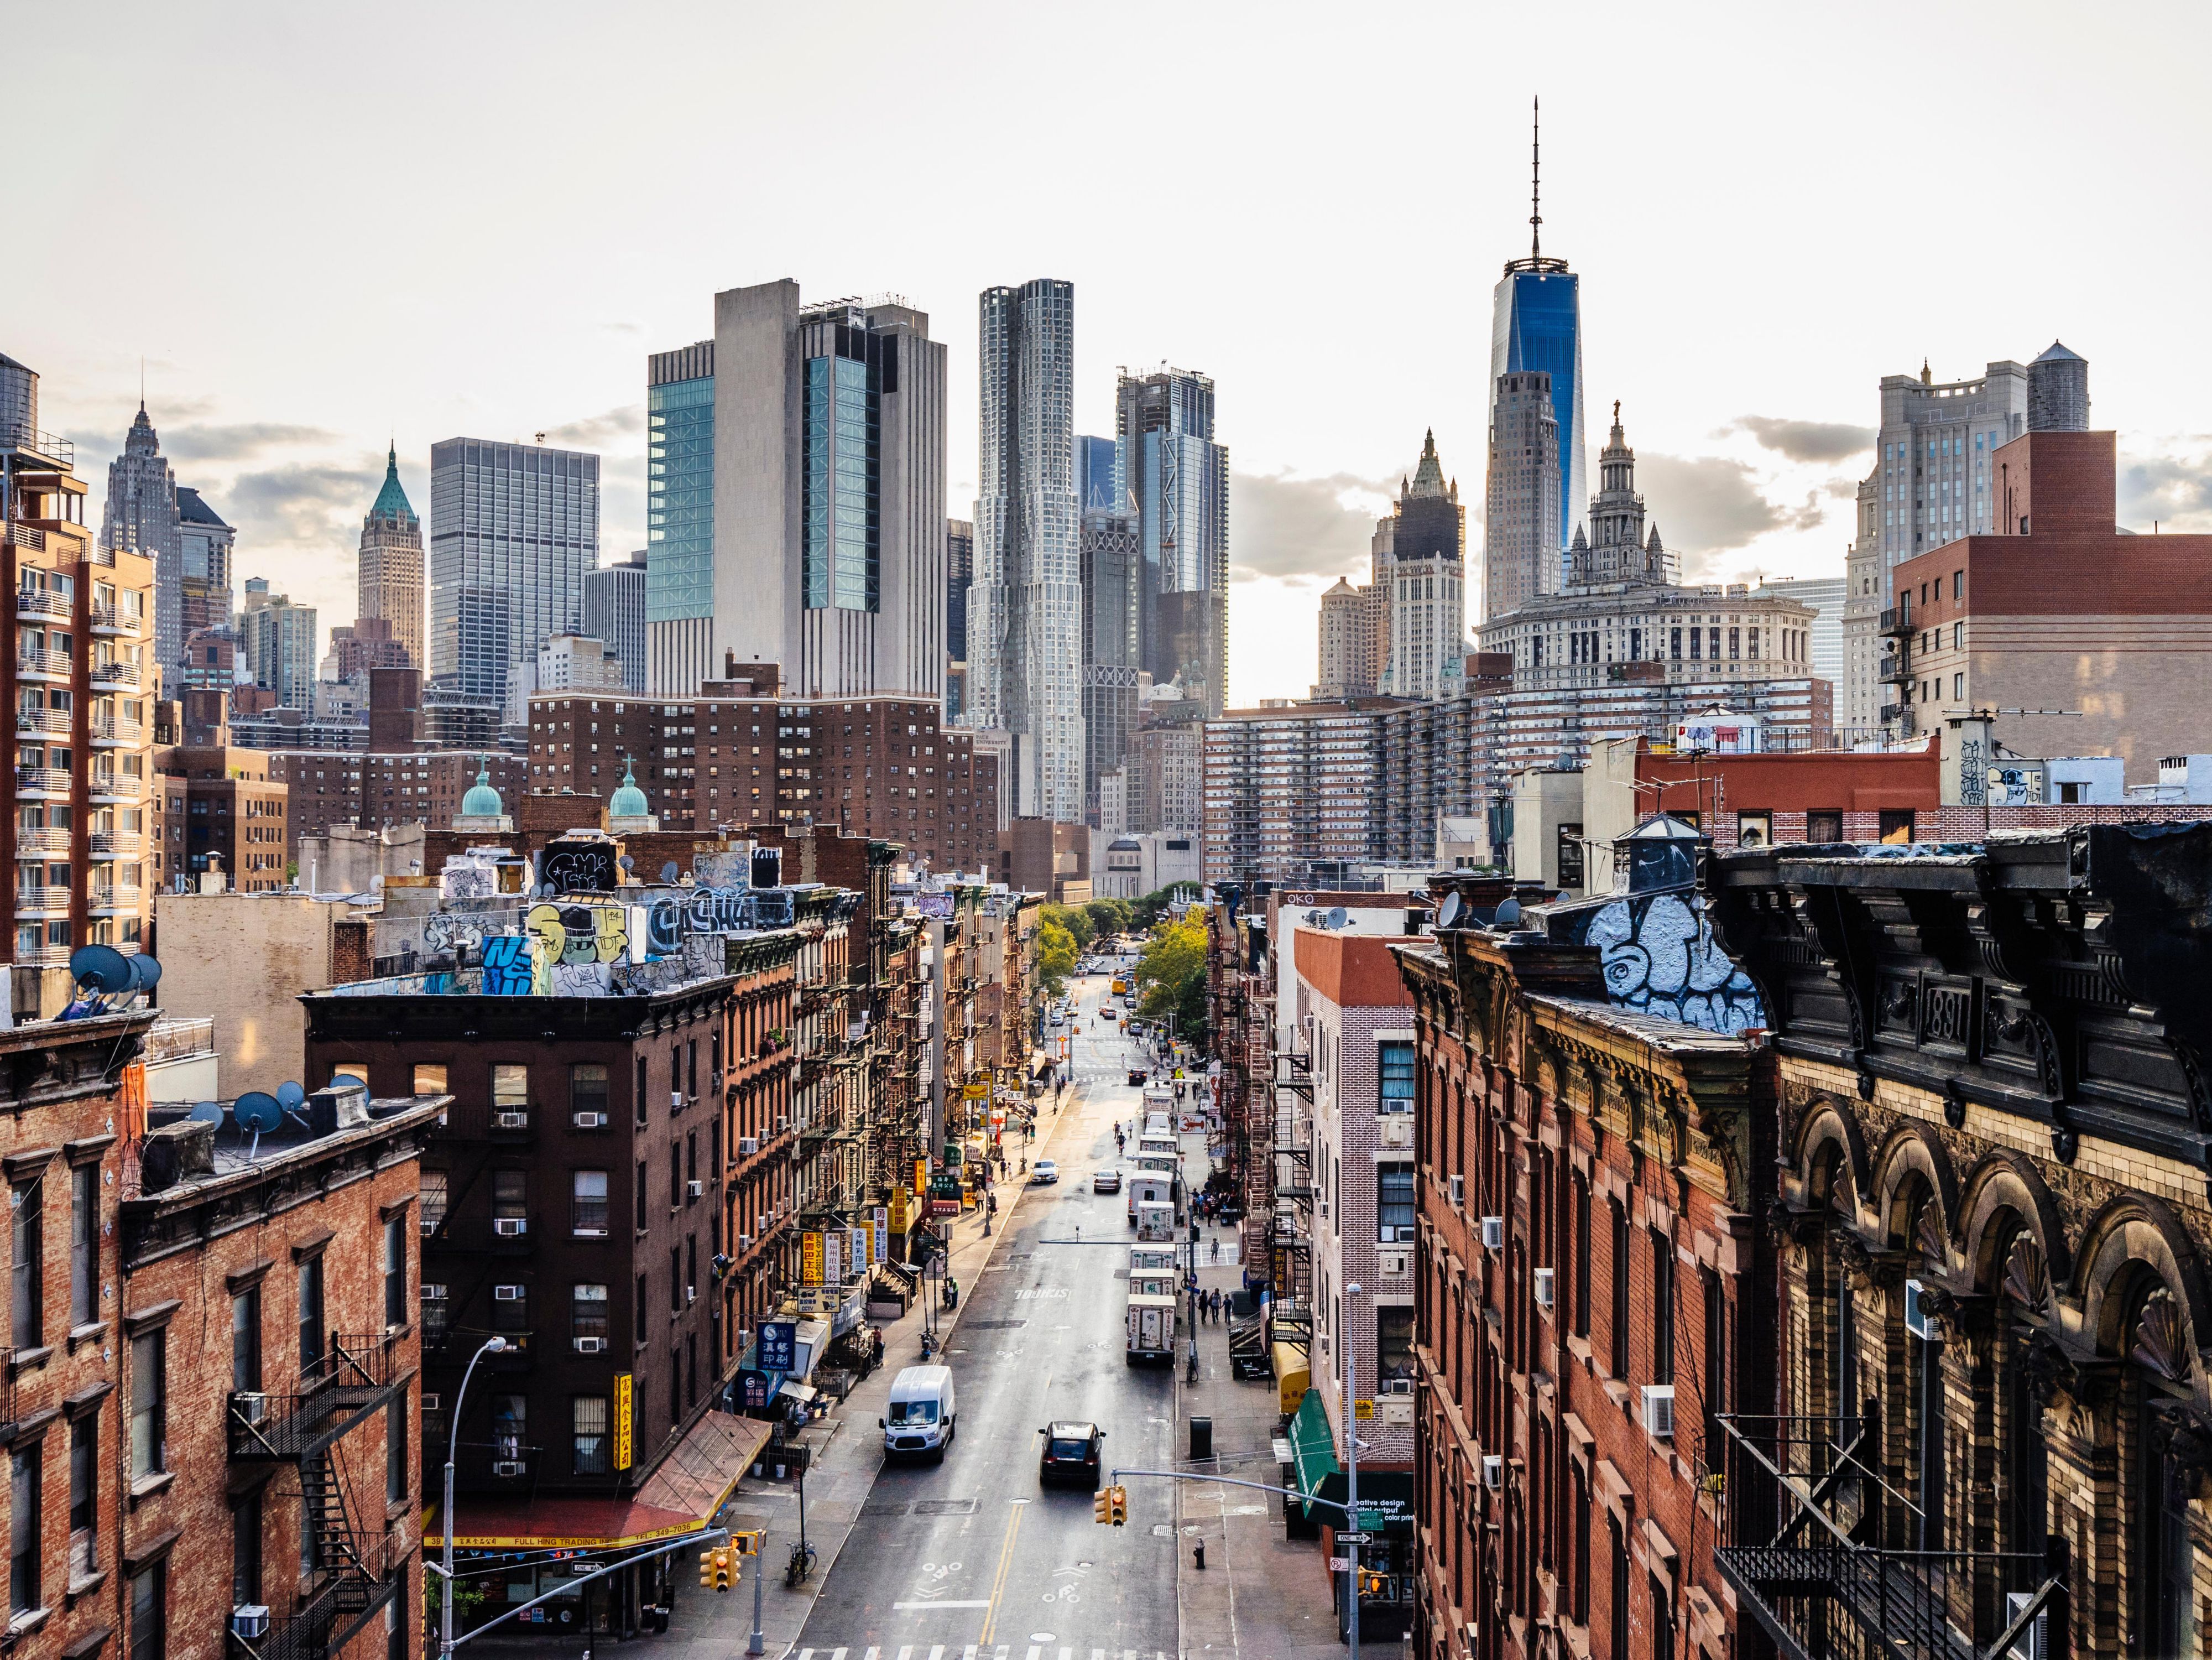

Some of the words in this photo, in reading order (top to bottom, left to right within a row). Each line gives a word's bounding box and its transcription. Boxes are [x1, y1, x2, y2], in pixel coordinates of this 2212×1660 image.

[1287, 894, 1314, 904] OKO
[1925, 988, 1963, 1042] 1891
[1014, 1288, 1069, 1300] SCHOOL
[1380, 1499, 1405, 1507] design
[635, 1532, 653, 1541] TEL:
[655, 1523, 691, 1537] 349-7036
